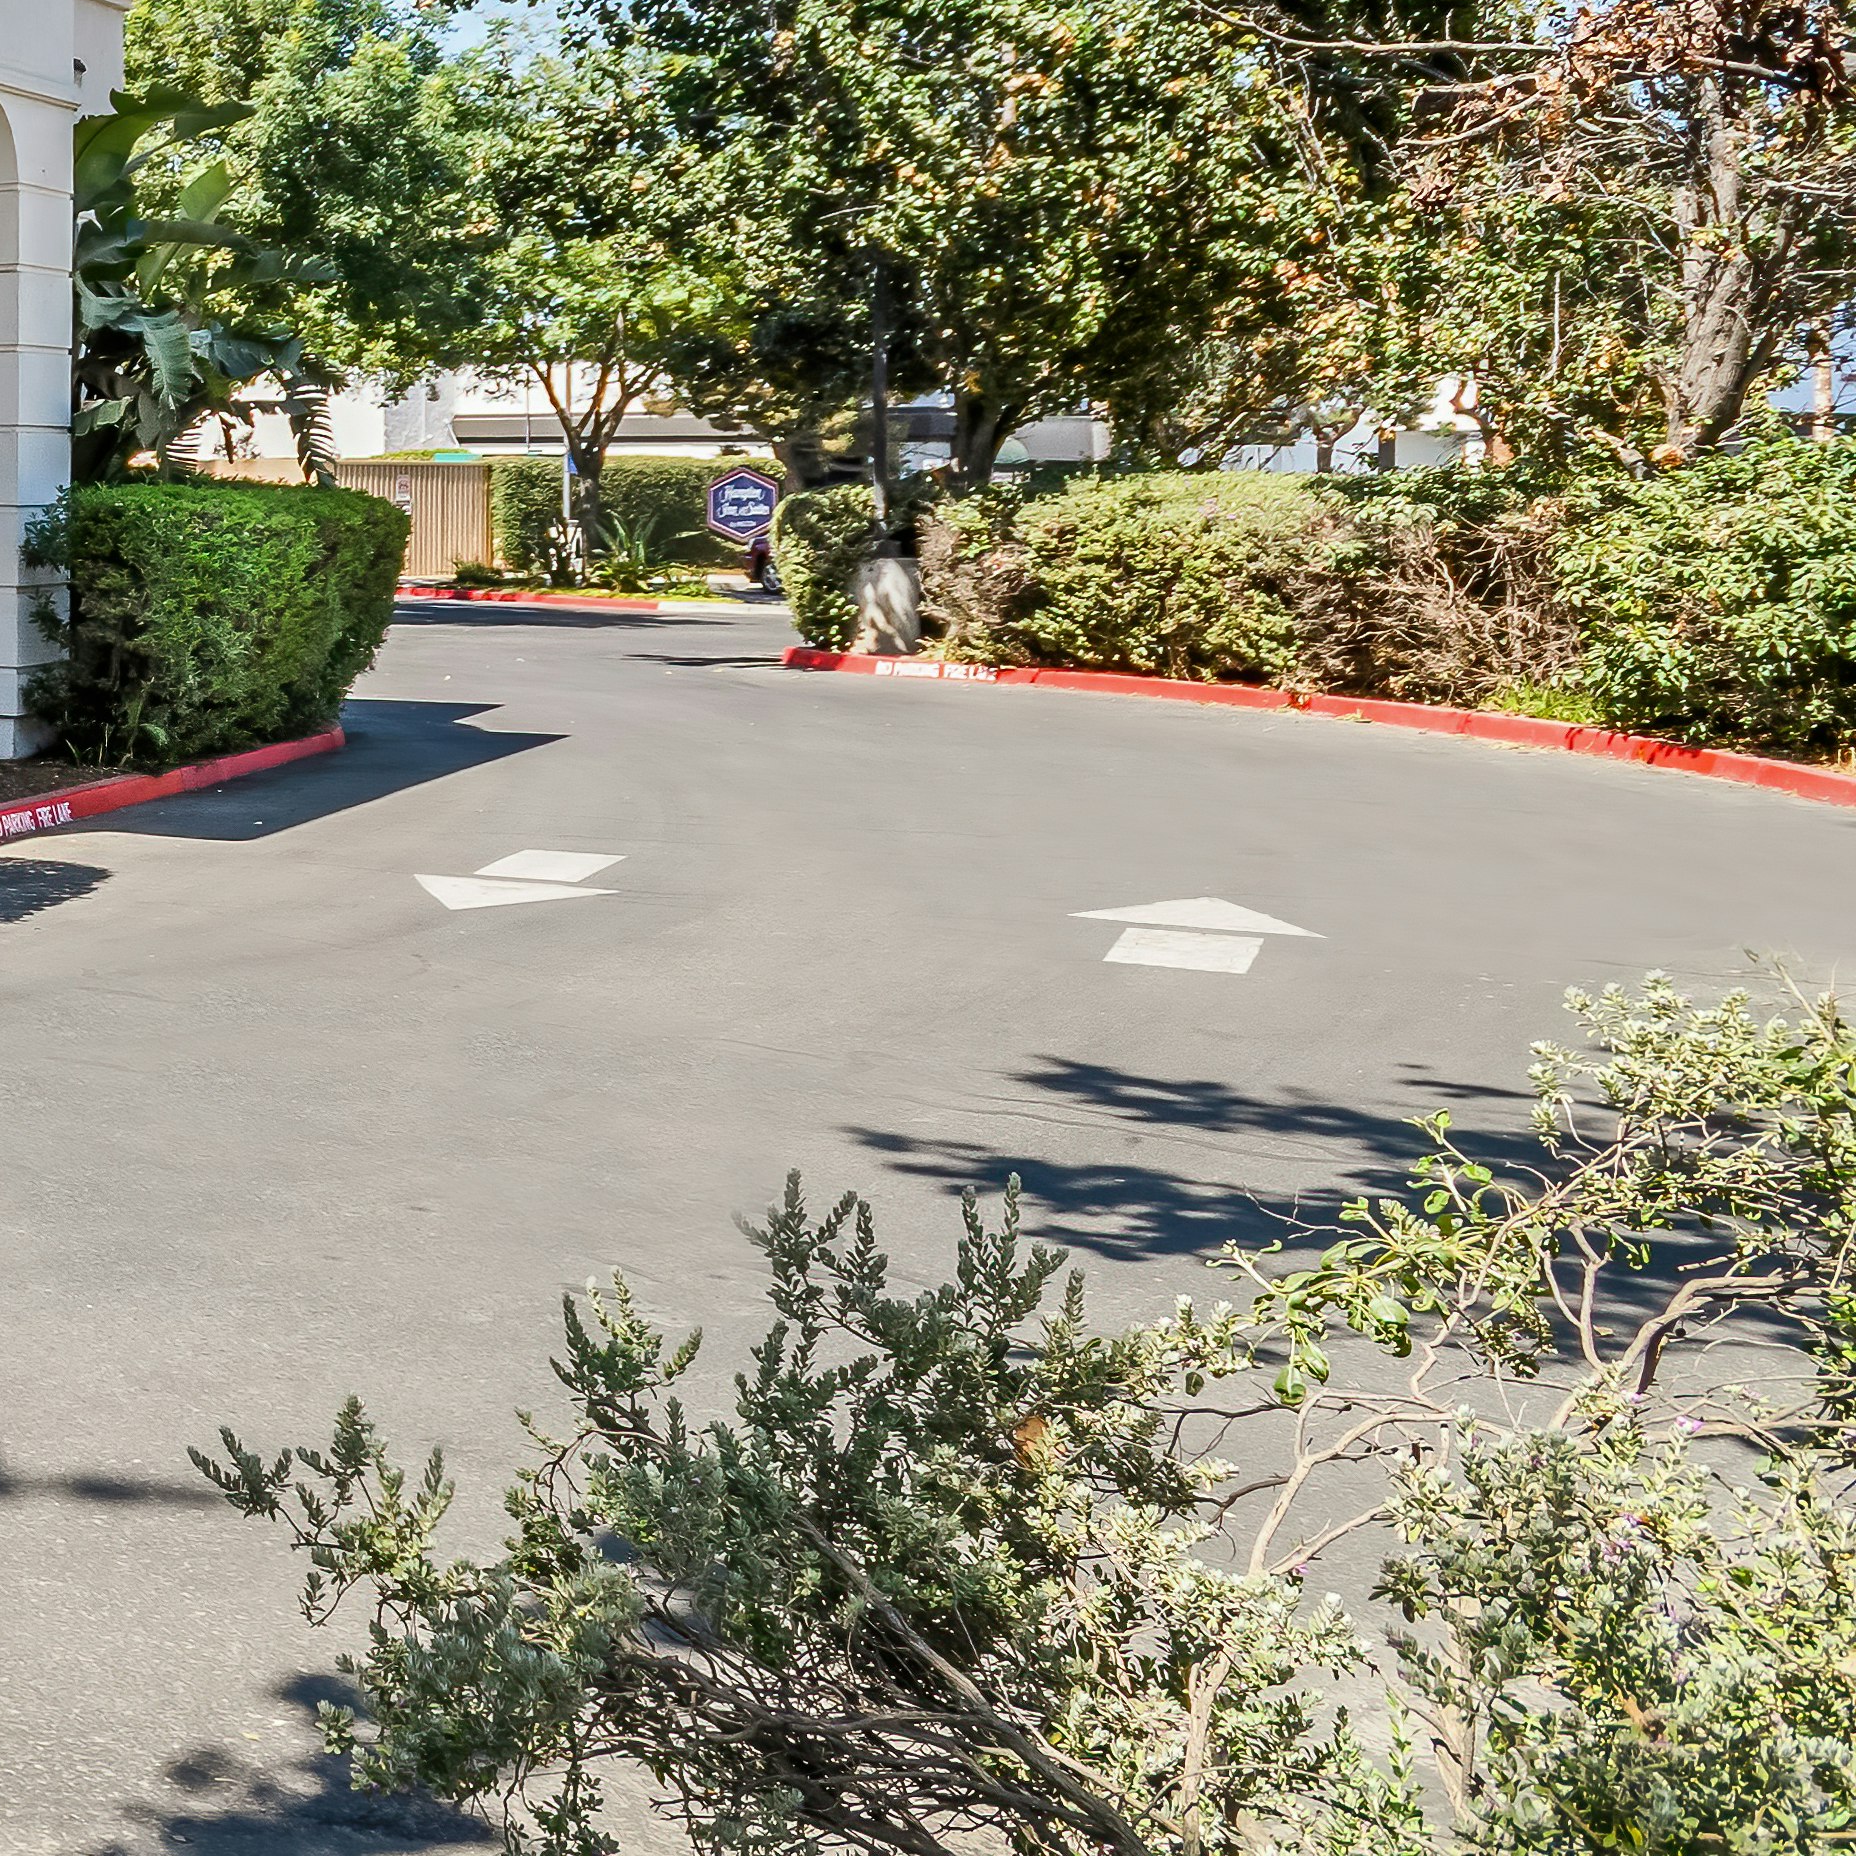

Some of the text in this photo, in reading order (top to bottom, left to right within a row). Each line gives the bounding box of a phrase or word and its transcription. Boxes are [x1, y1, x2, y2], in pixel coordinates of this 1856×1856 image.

[1, 810, 36, 836] PARKING
[35, 805, 55, 828] FIRE
[52, 802, 73, 825] LANE
